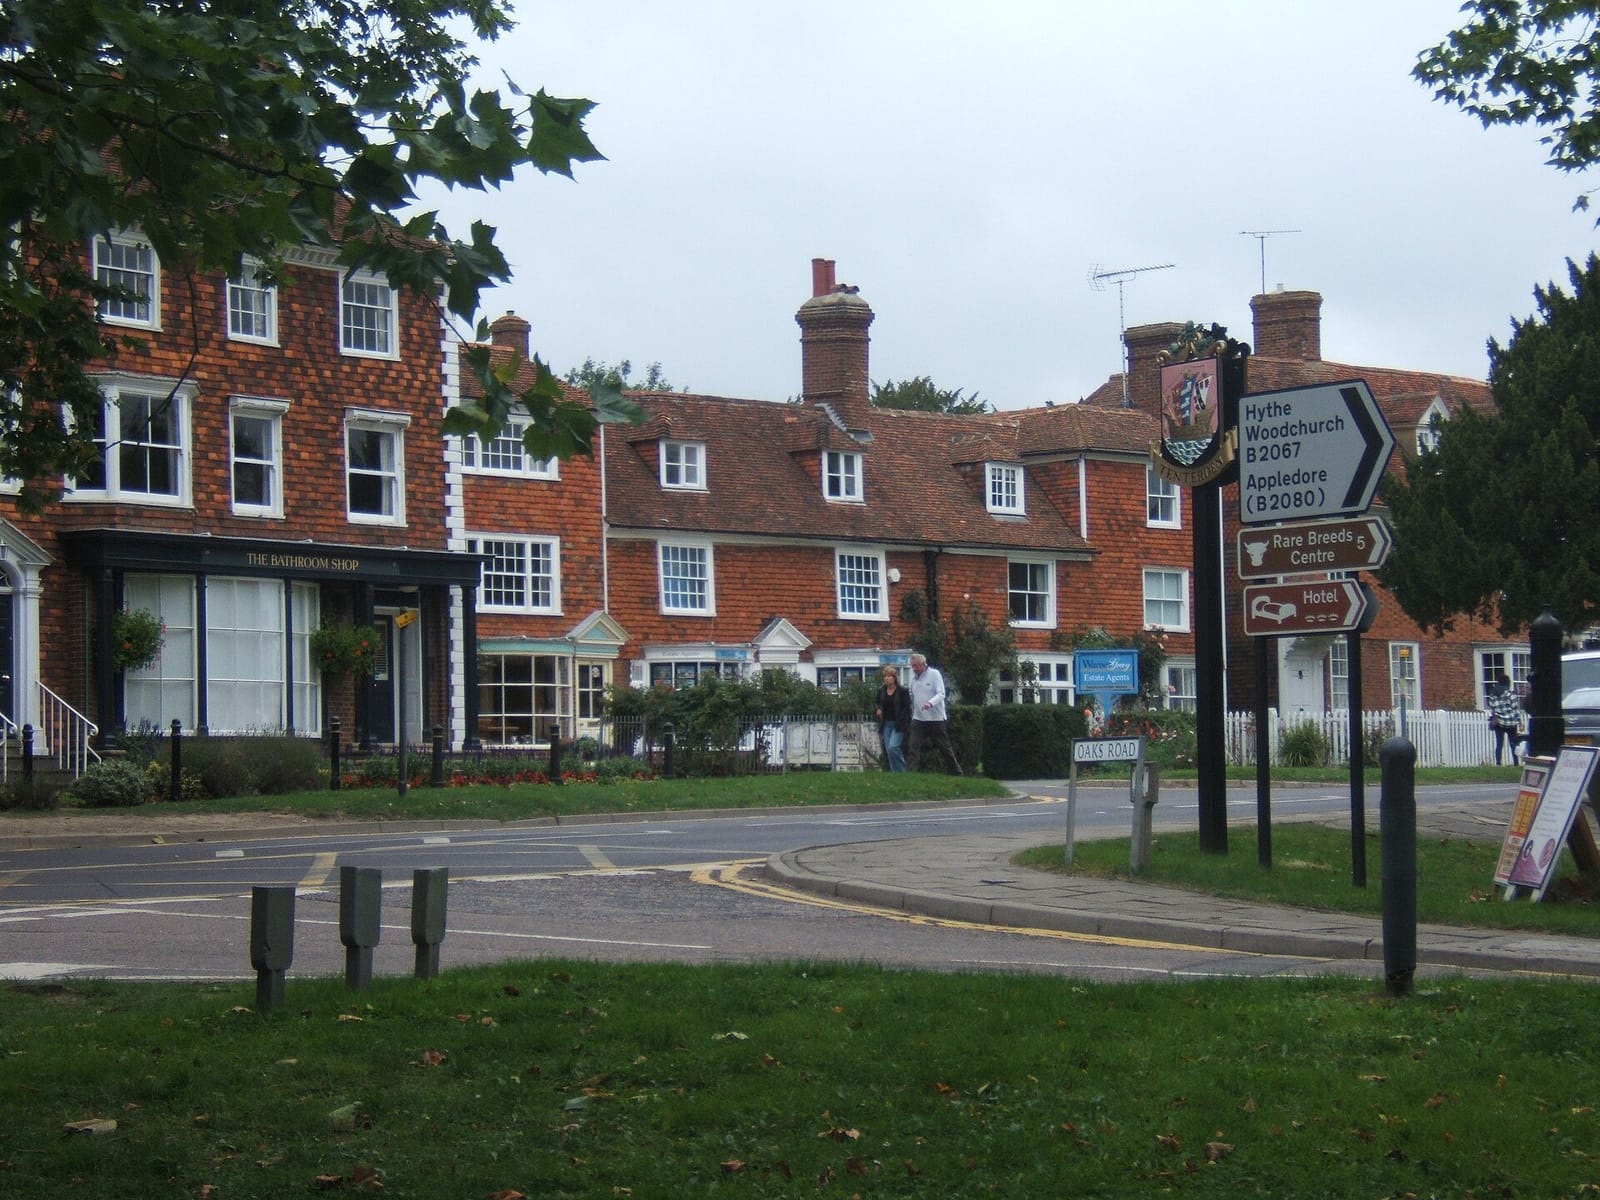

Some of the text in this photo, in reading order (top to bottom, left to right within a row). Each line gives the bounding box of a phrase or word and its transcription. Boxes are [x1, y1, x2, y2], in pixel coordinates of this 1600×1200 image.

[1245, 401, 1292, 422] Hythe
[1245, 415, 1345, 442] Woodchurch
[1246, 469, 1328, 492] Appledore
[1246, 487, 1326, 514] (B2080)
[1273, 529, 1353, 549] Rare Breeds
[1356, 535, 1366, 550] 5
[246, 552, 359, 571] THE BATHROOM SHOP
[1290, 550, 1336, 565] Centre
[1303, 588, 1338, 605] Hotel
[1083, 673, 1130, 683] Estate Agents
[1077, 742, 1136, 759] OAKS ROAD
